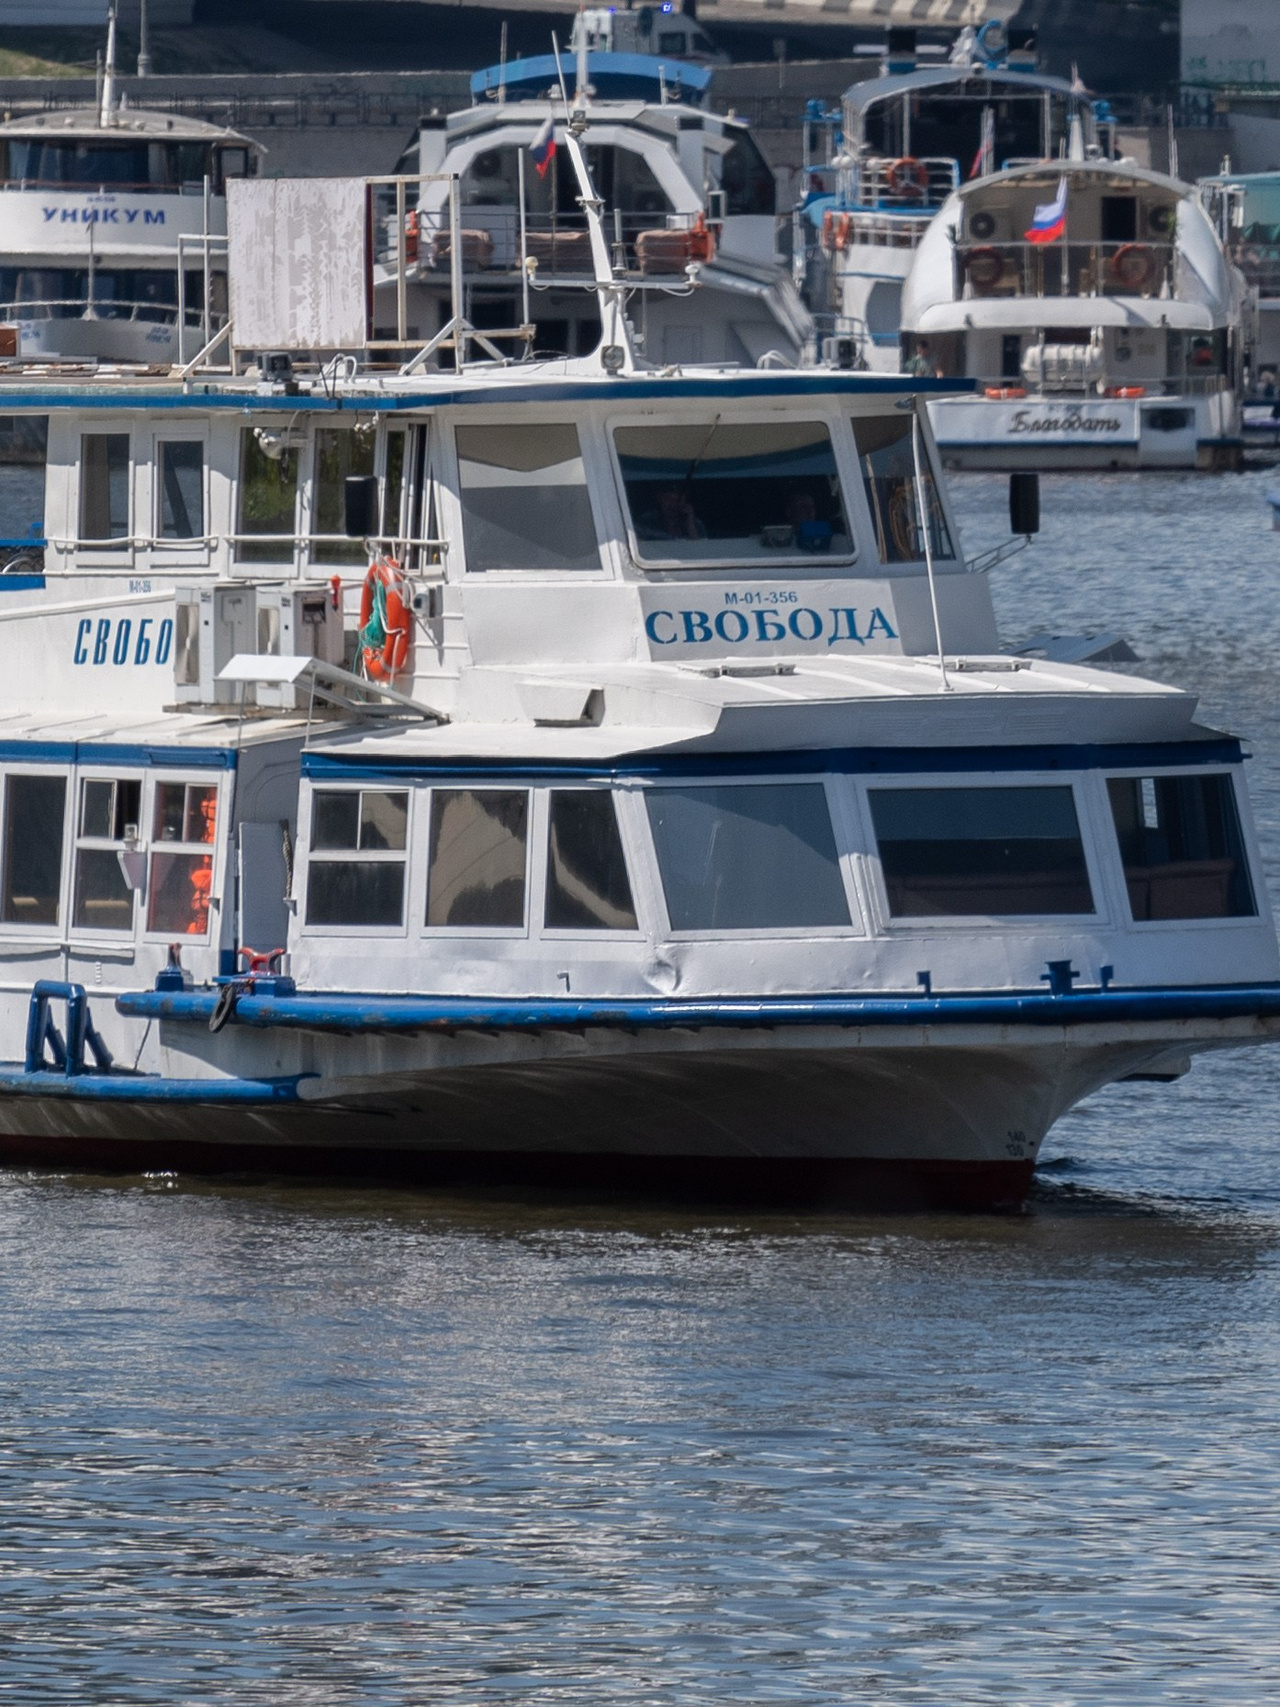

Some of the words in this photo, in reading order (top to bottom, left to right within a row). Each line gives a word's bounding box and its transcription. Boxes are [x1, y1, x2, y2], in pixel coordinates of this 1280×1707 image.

[43, 207, 165, 224] УНИКУМ
[1007, 411, 1121, 433] Благодать
[74, 618, 174, 665] СВОБО
[645, 607, 899, 646] СВОБОДА
